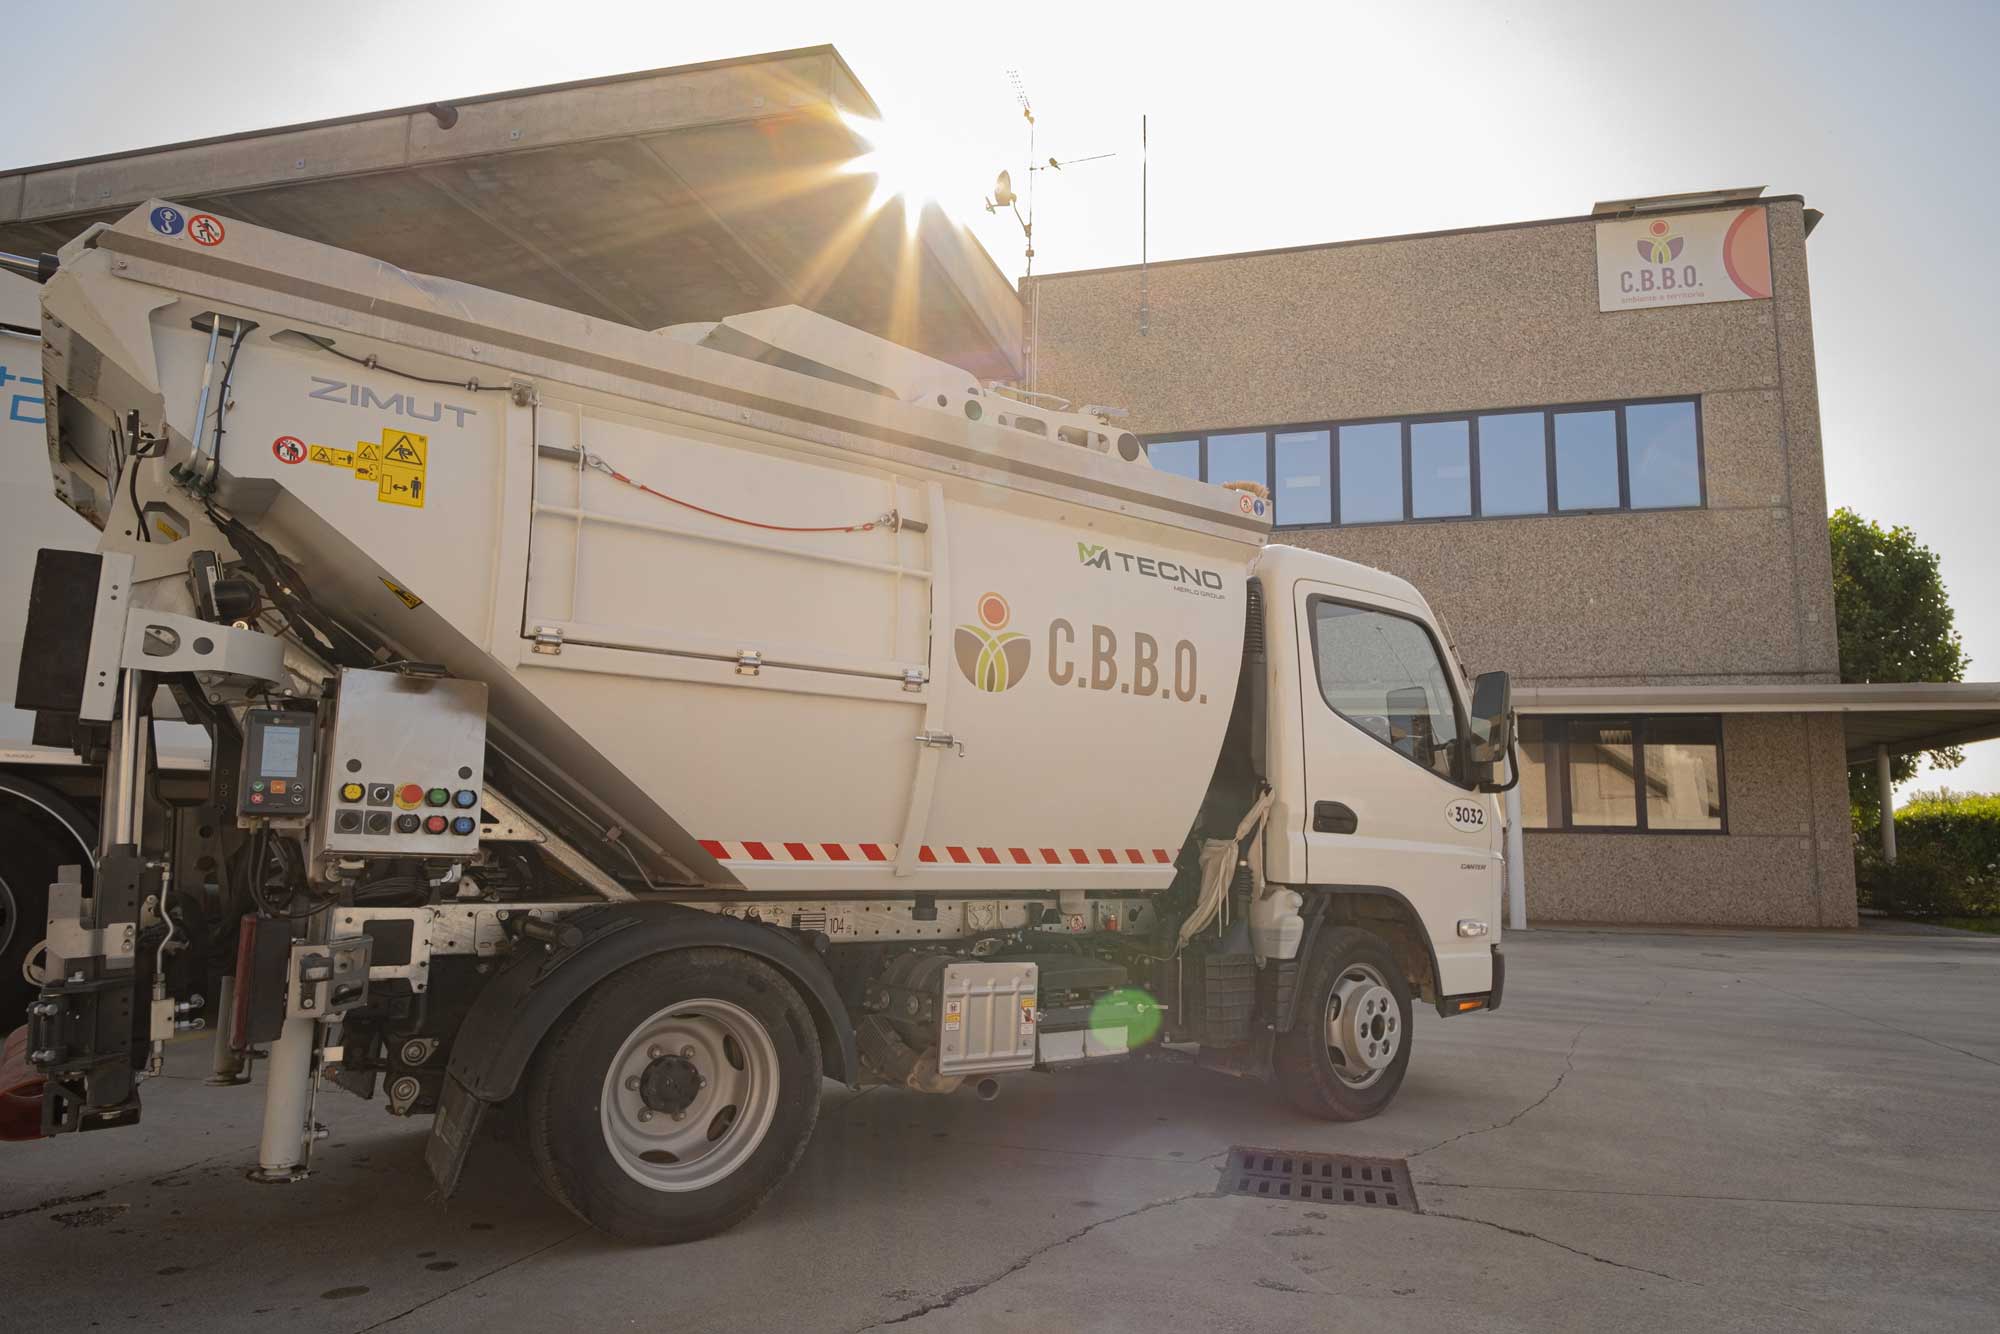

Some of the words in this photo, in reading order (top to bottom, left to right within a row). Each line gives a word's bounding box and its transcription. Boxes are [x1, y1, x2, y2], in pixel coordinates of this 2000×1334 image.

[1620, 265, 1703, 293] C.B.B.O.
[309, 376, 477, 428] ZIMUT
[1114, 551, 1222, 590] TECNO
[1173, 586, 1200, 596] MERLO
[1200, 591, 1225, 600] GROUP
[1048, 617, 1208, 704] C.B.B.O.
[1455, 806, 1484, 825] 3032
[829, 917, 844, 934] 104
